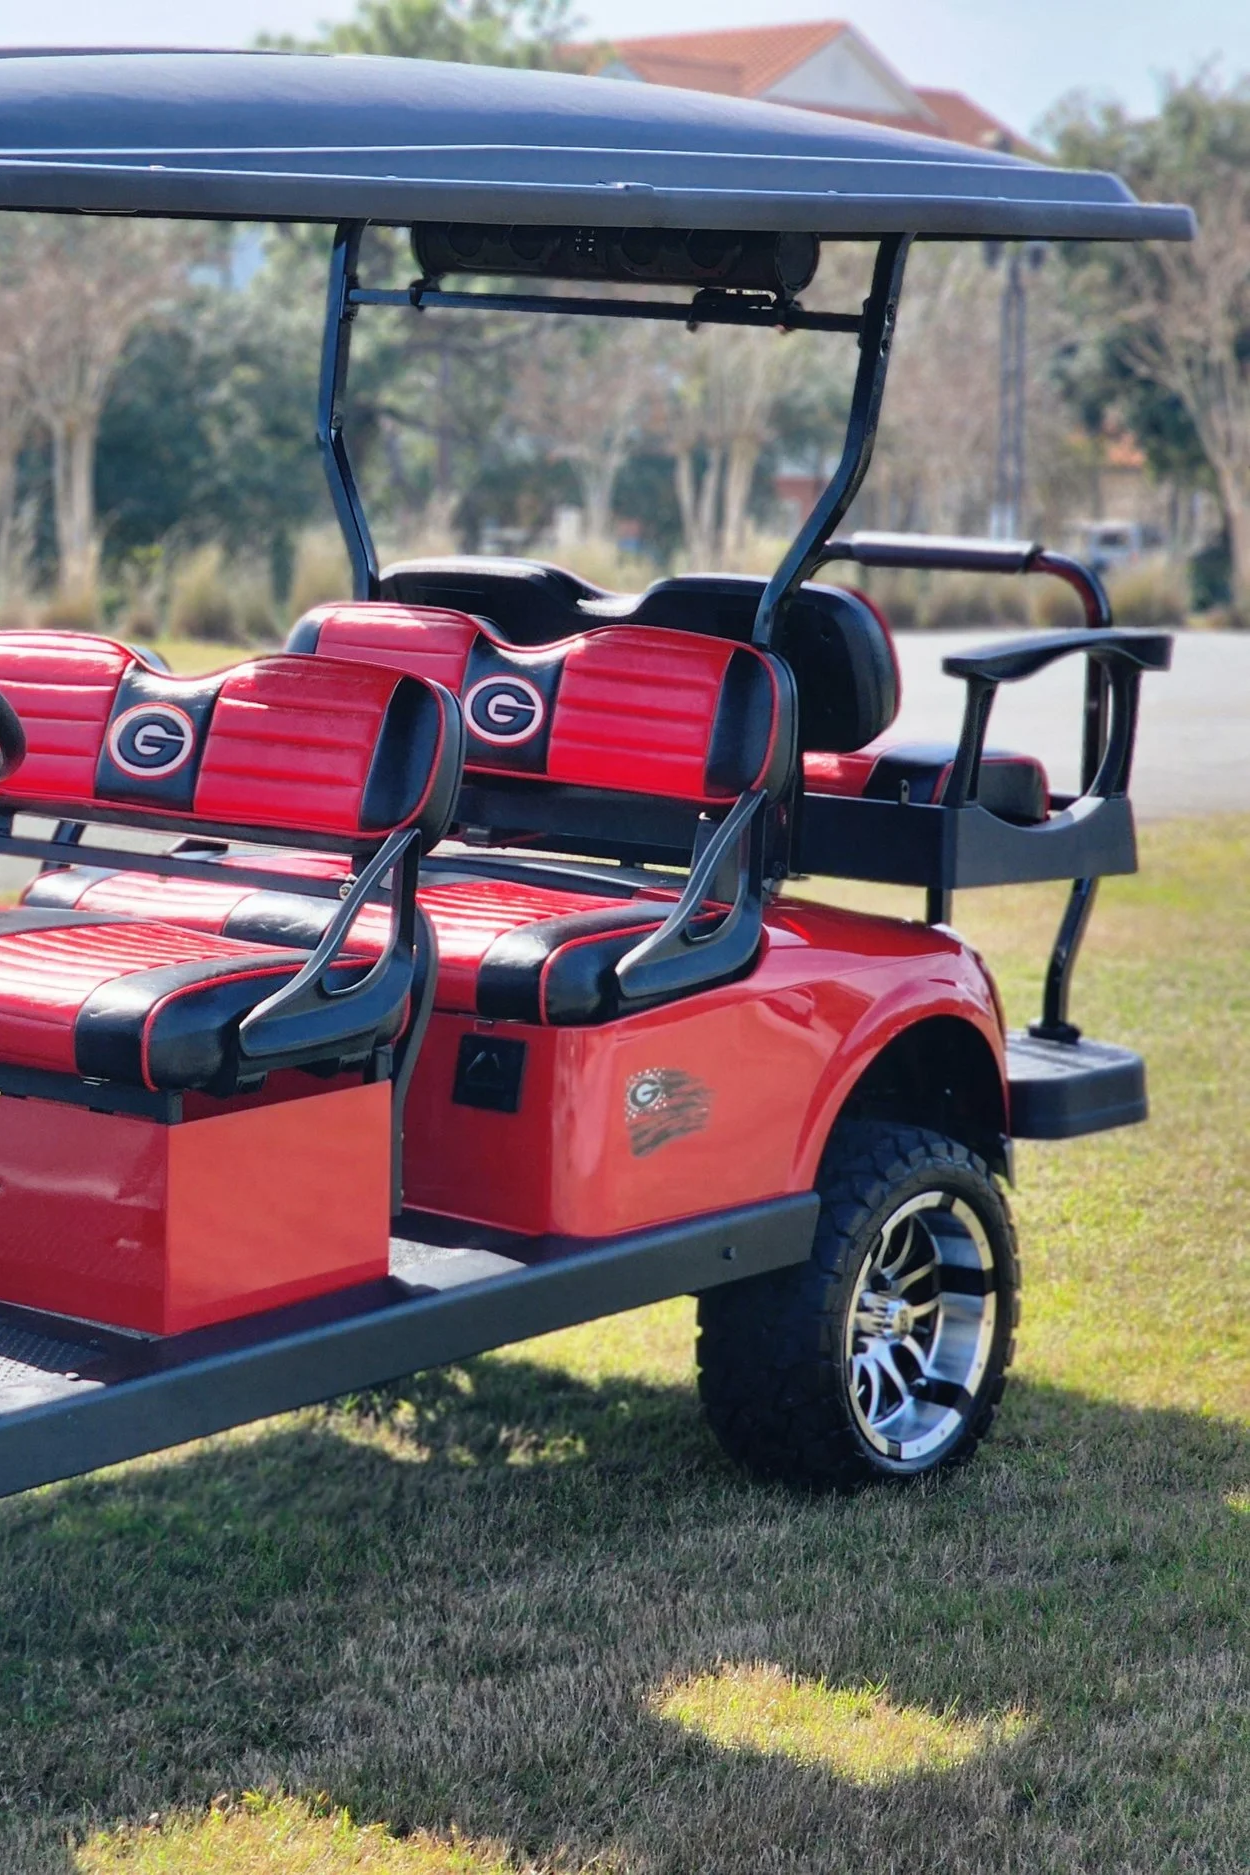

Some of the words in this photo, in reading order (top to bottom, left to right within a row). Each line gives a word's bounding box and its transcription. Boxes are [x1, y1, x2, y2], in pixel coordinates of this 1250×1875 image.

[471, 683, 536, 736] G
[117, 712, 186, 769] G
[629, 1077, 661, 1108] G
